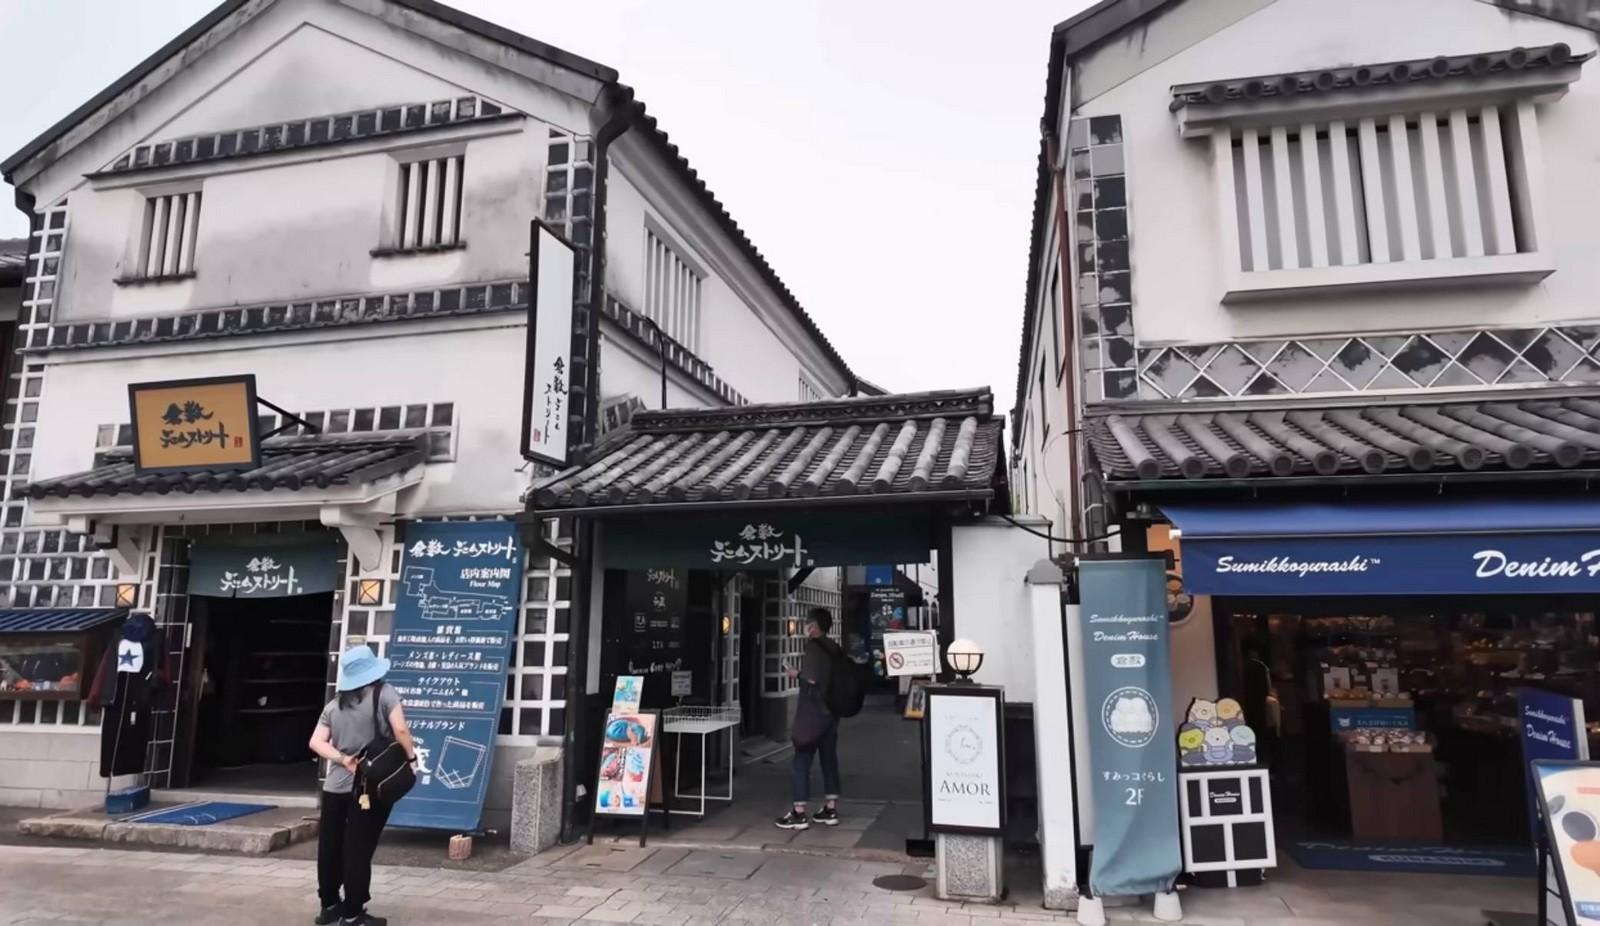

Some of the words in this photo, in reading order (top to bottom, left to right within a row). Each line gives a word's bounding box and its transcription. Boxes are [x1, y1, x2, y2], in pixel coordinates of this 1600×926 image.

[161, 400, 214, 425] 倉敷
[160, 421, 229, 449] デニムストリート
[737, 523, 784, 540] 倉敷
[408, 538, 451, 558] 倉敷
[453, 536, 517, 560] デニムストリート
[710, 534, 808, 566] デニムストリート
[246, 555, 282, 572] 倉敷
[1472, 549, 1582, 578] Denim
[219, 565, 299, 595] デニムストリート
[487, 581, 501, 590] Map
[1093, 631, 1126, 642] Denim
[1126, 631, 1159, 641] House
[408, 719, 465, 731] リジナルブランド
[1526, 723, 1548, 742] Denim
[1547, 730, 1571, 749] House
[940, 780, 992, 796] AMOR
[1125, 788, 1145, 806] 2F
